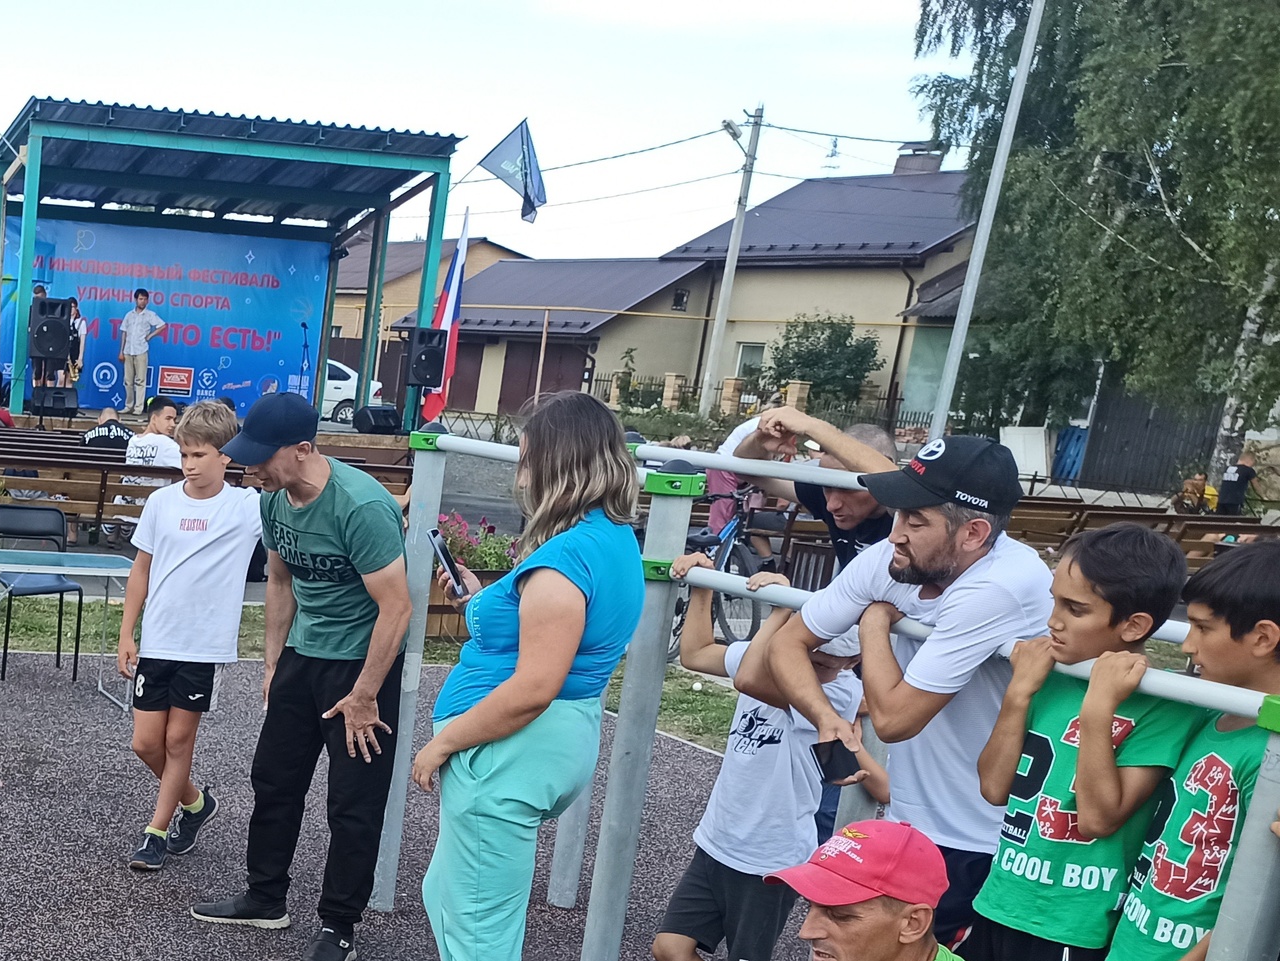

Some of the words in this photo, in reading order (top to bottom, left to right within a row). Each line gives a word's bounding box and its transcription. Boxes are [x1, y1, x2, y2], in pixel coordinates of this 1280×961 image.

[49, 256, 183, 281] ИНКЛЮЗИВНЫЙ
[188, 269, 281, 289] ФЕСТИВАЛЬ
[77, 285, 165, 306] УЛИЧНГО
[170, 292, 231, 311] СПОРТА
[196, 389, 216, 397] DANCE
[955, 490, 989, 509] TOYOTA
[277, 544, 309, 568] OME
[135, 674, 146, 697] 8
[1001, 847, 1054, 885] COOL
[1062, 863, 1118, 891] BOY
[1123, 892, 1151, 936] COOL
[1153, 917, 1211, 949] BOY
